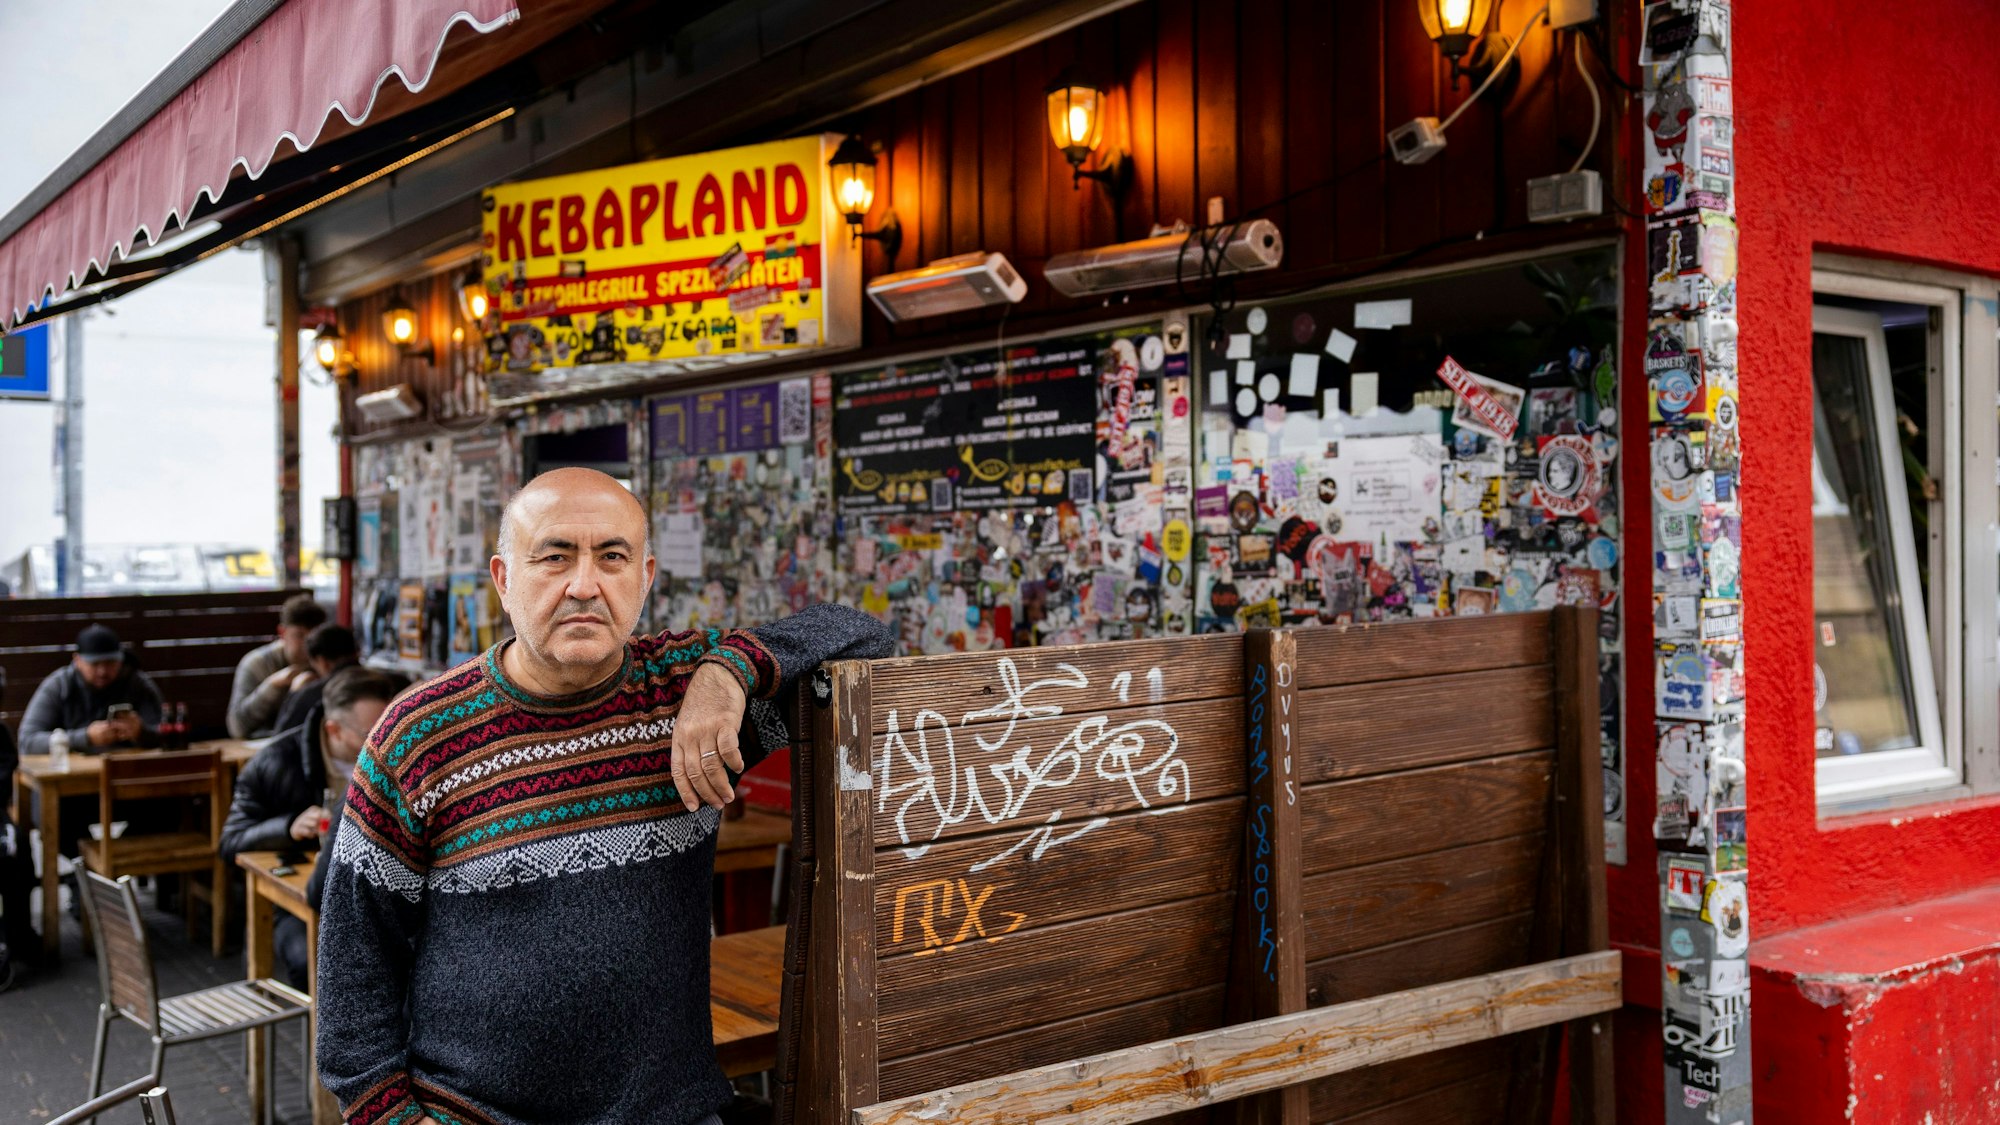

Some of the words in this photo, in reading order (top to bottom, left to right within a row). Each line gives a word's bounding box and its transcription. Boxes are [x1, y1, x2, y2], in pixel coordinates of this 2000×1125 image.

[499, 163, 809, 262] KEBAPLAND
[1439, 361, 1473, 395] SEIT
[1647, 356, 1685, 370] BASKETS
